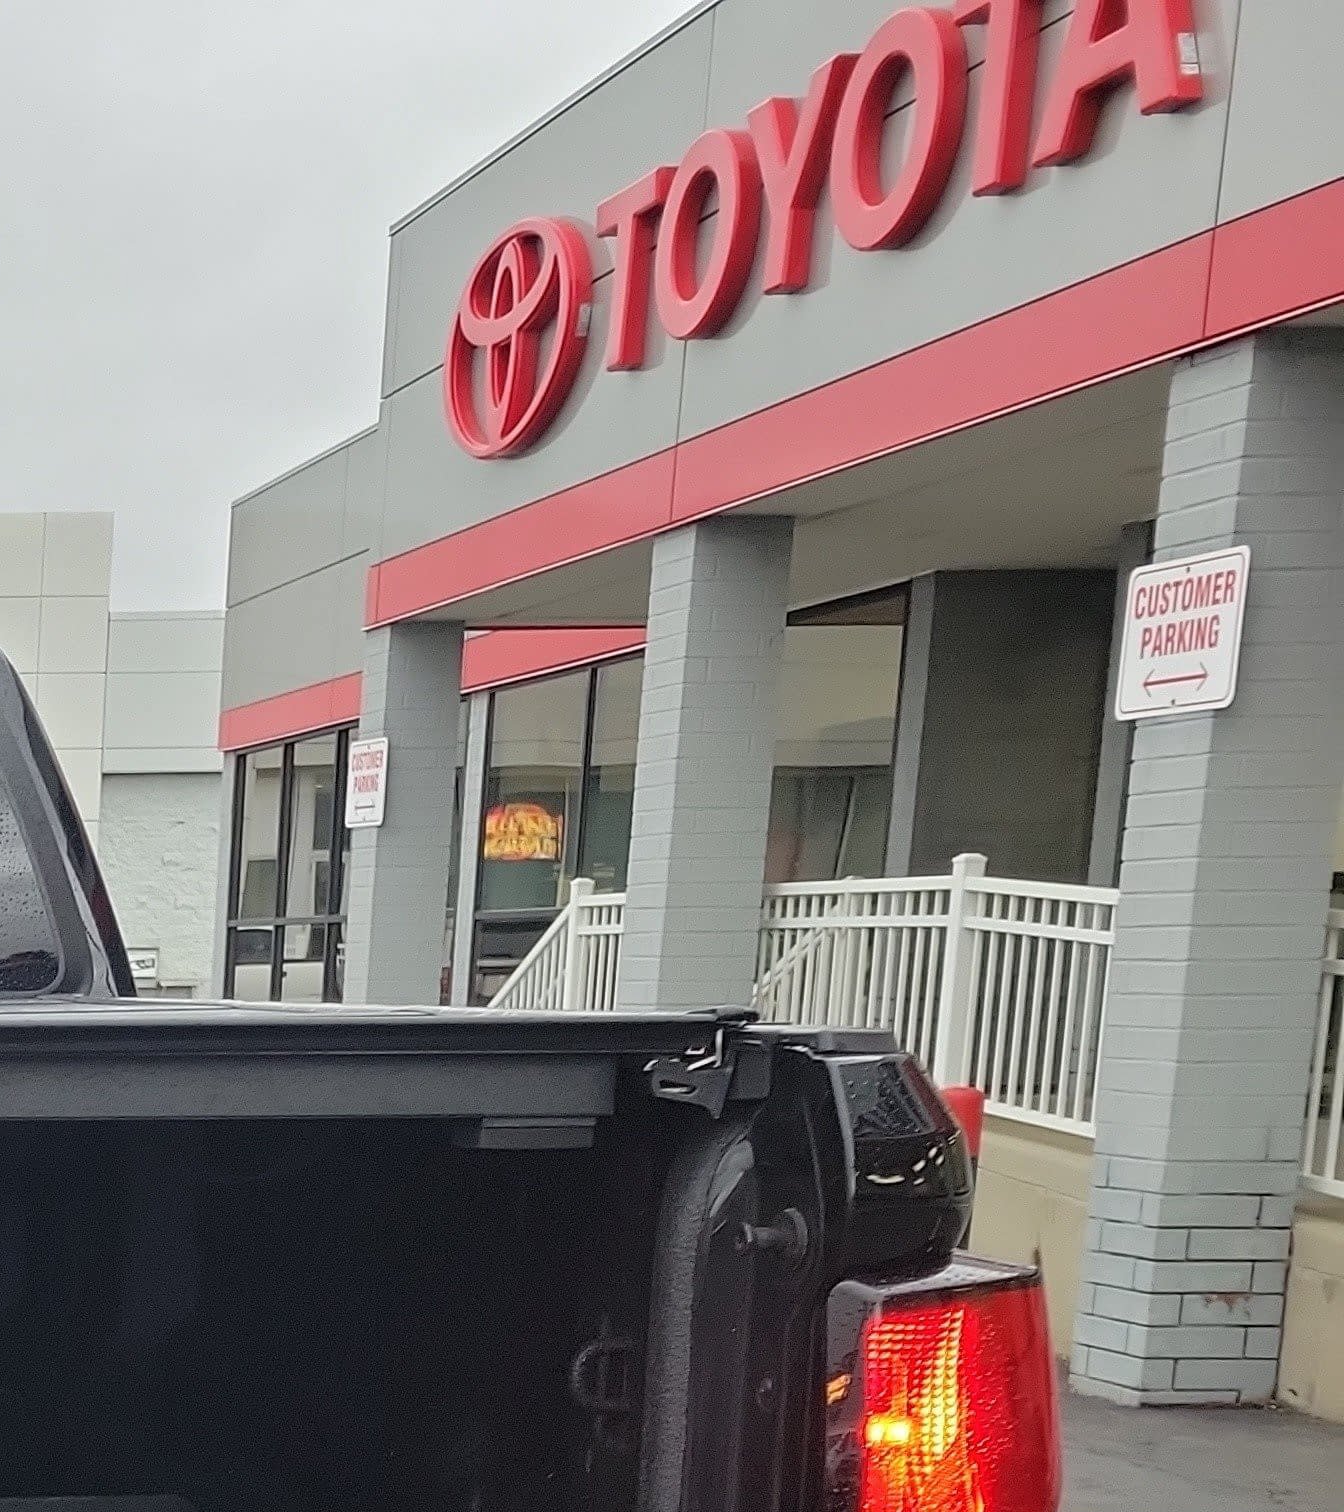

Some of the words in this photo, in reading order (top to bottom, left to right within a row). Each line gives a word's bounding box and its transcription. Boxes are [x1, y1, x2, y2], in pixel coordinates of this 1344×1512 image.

[596, 0, 1204, 371] TOYOTA
[1134, 569, 1237, 620] CUSTOMER
[1139, 614, 1221, 660] PARKING
